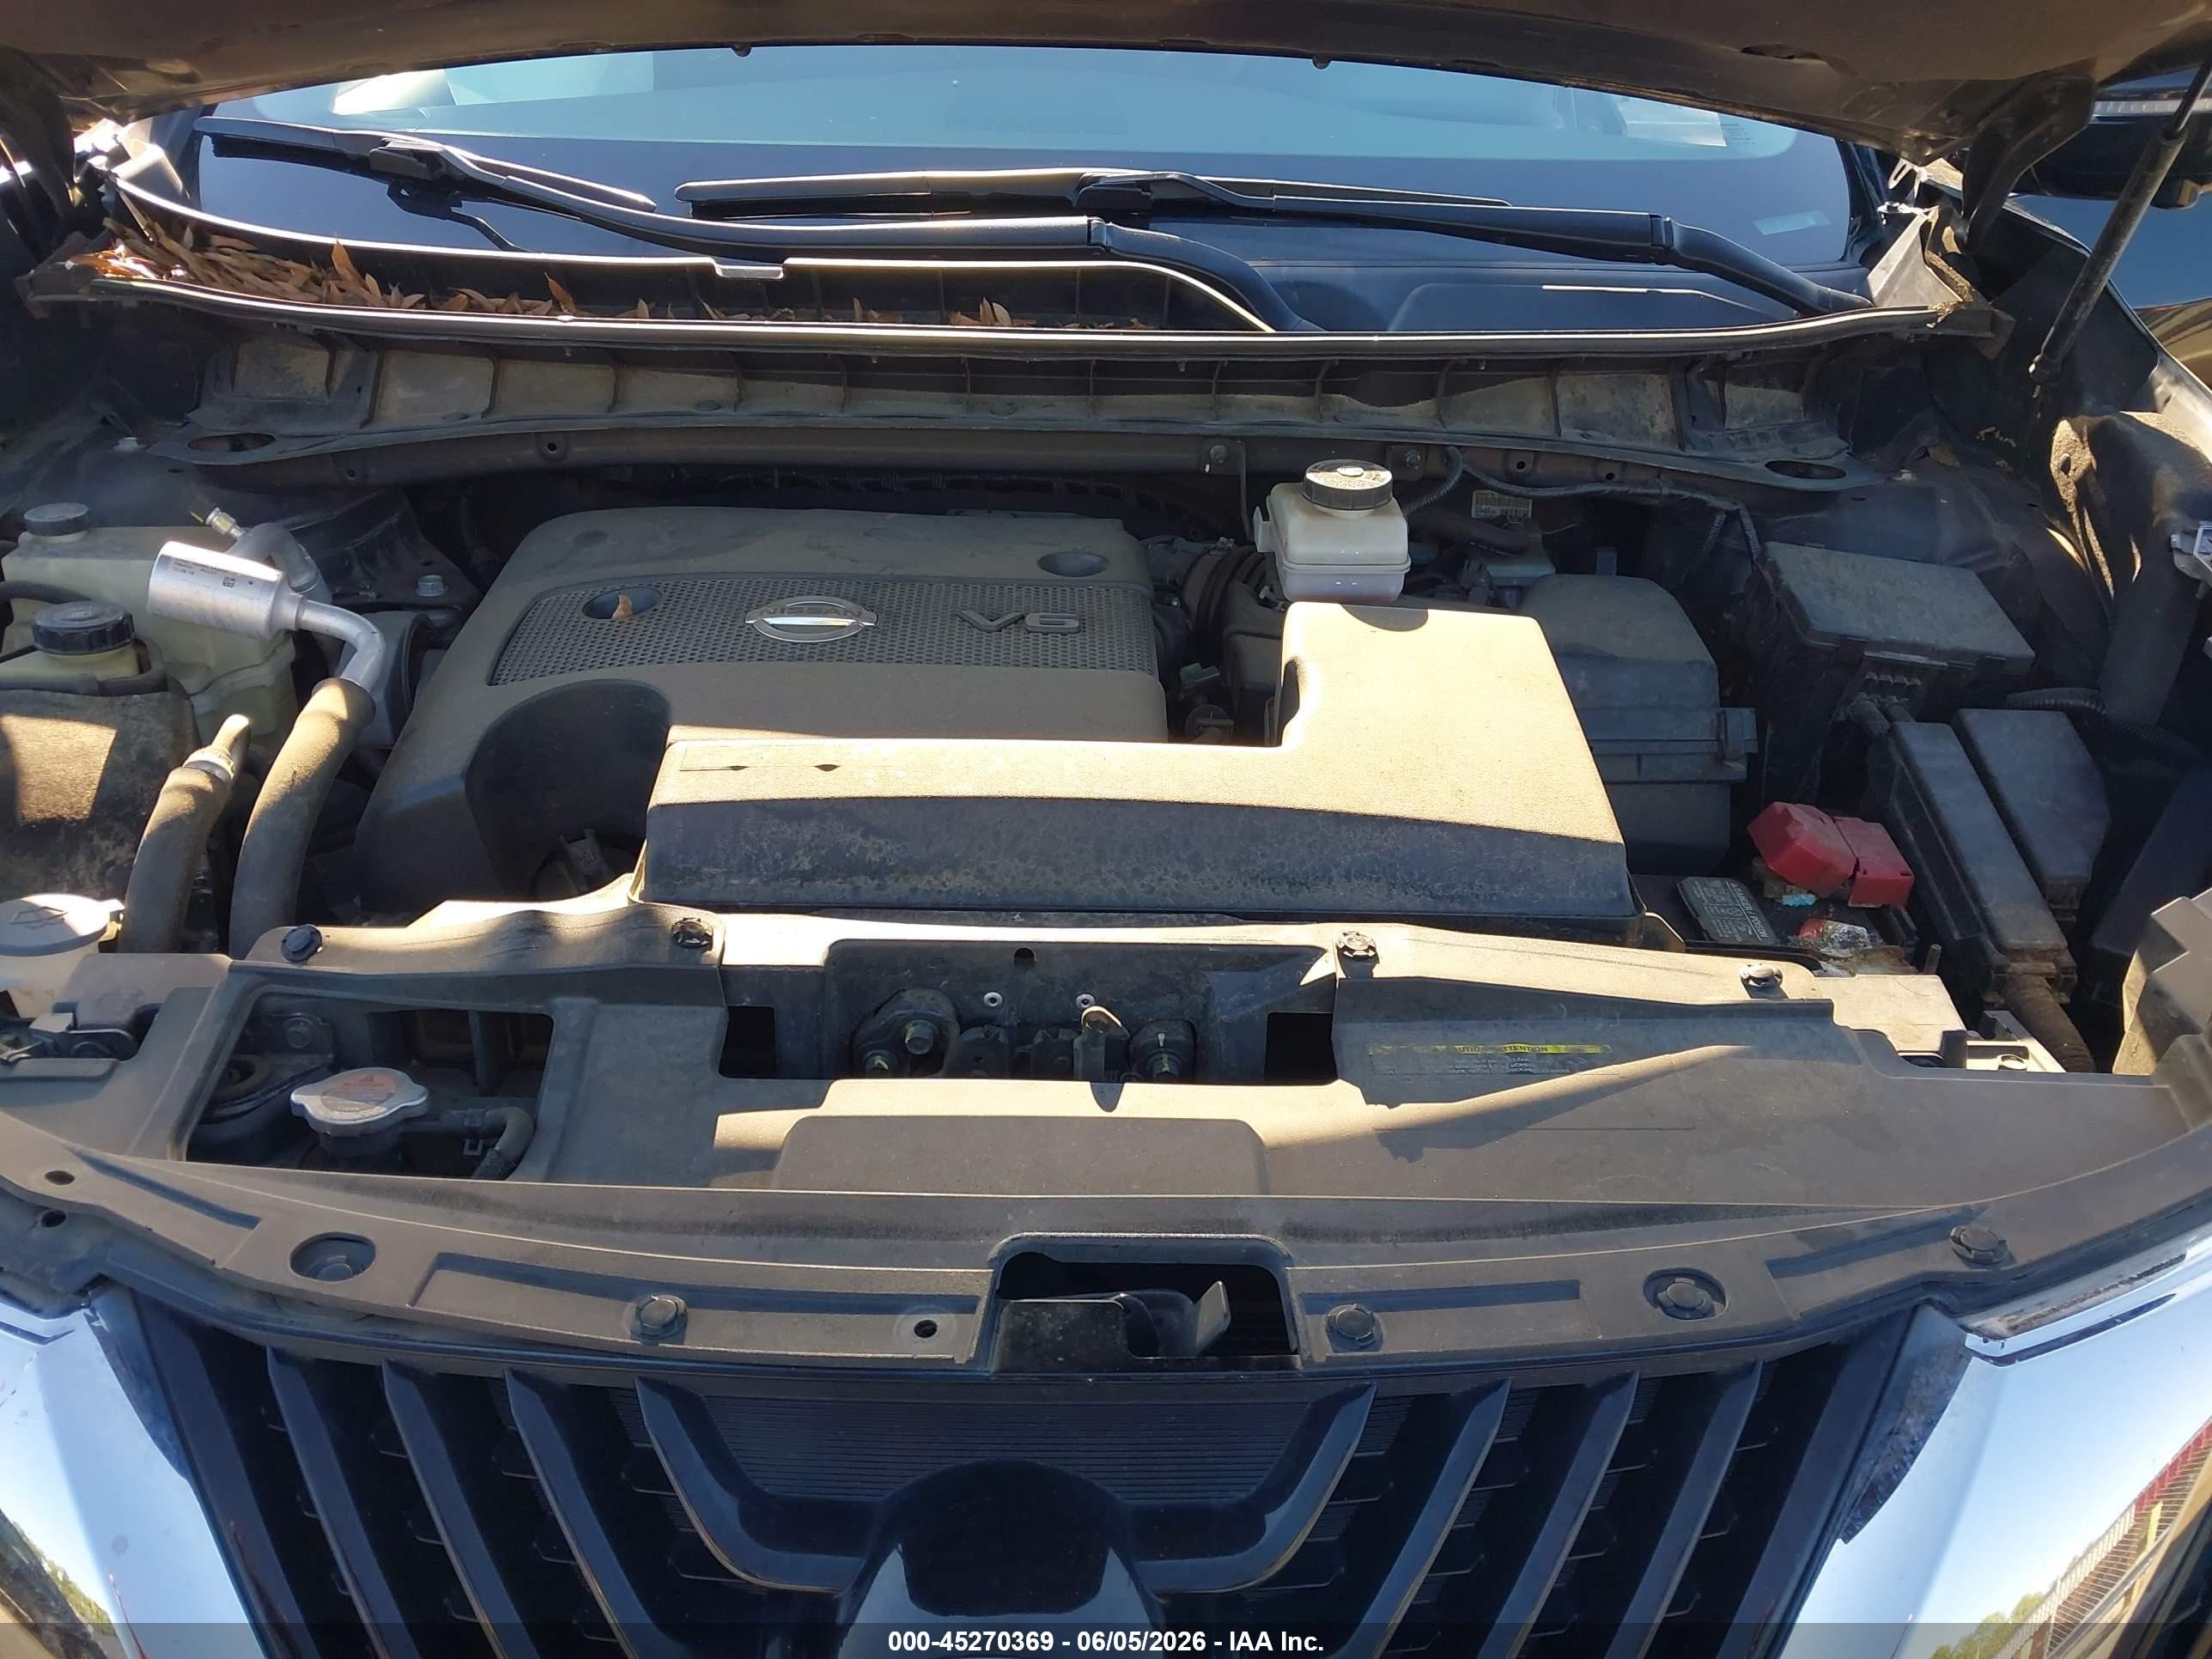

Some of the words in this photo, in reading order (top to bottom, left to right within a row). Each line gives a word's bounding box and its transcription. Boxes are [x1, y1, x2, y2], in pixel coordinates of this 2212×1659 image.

[758, 606, 863, 617] NISSAN
[953, 609, 1081, 634] V6
[1733, 888, 1753, 911] DANGER
[1749, 915, 1770, 937] POISON
